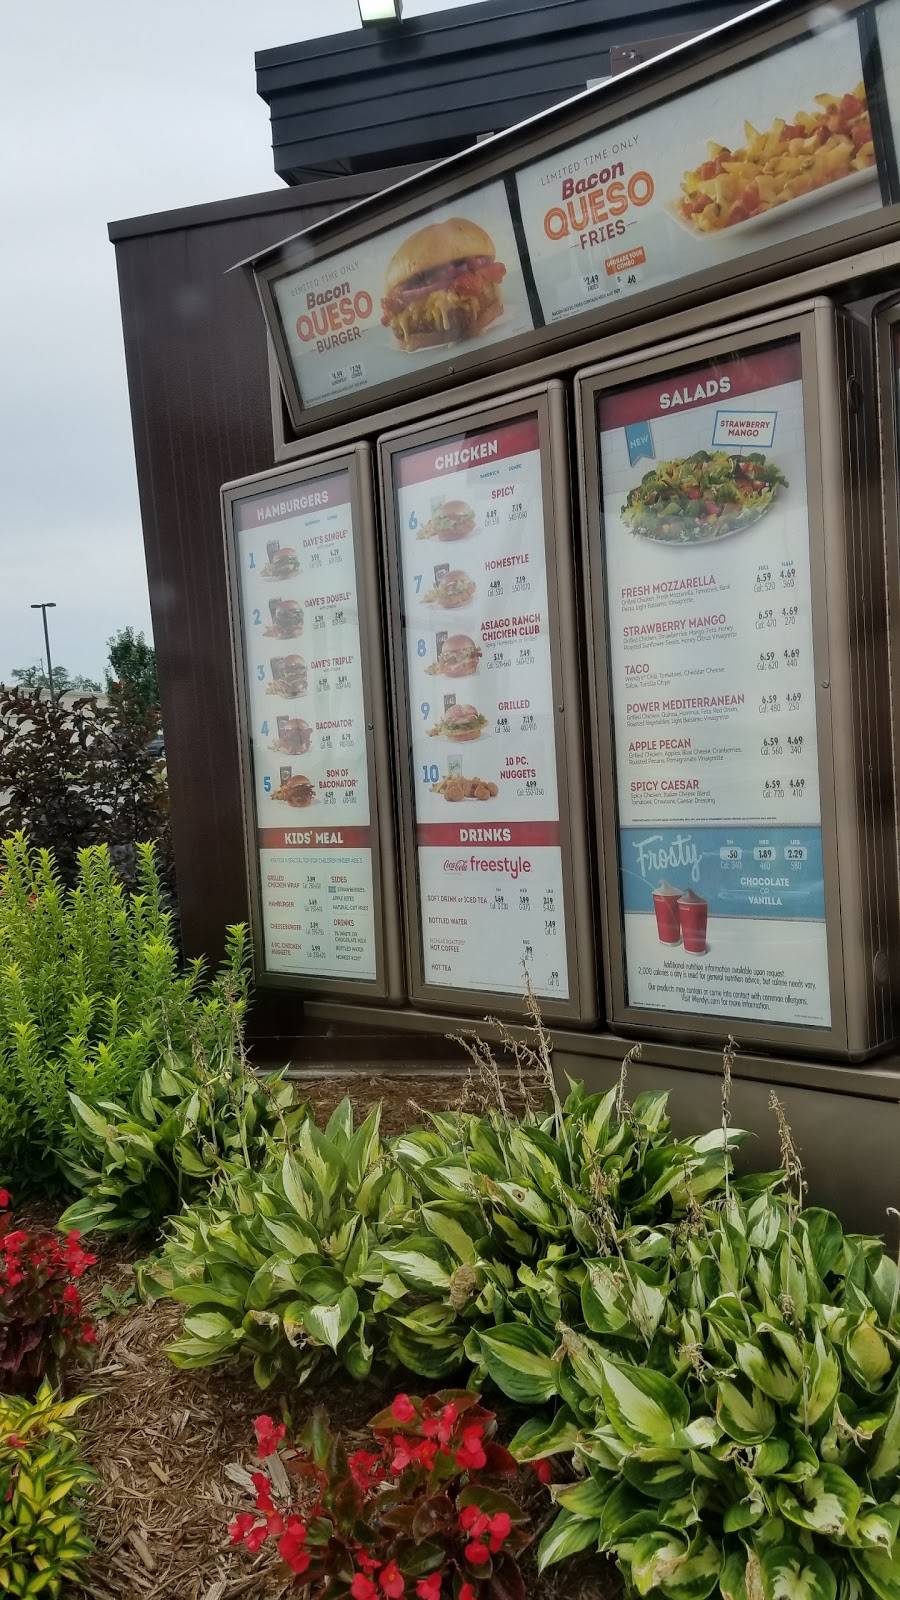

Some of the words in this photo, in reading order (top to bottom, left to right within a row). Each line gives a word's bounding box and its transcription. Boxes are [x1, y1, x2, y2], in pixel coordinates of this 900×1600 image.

[540, 162, 580, 186] LIMITED
[584, 149, 608, 168] TIME
[612, 135, 639, 154] ONLY
[562, 161, 624, 200] Bacon
[544, 170, 654, 240] QUESO
[579, 220, 626, 250] FRIES
[306, 281, 351, 310] Bacon
[296, 290, 373, 342] QUESO
[316, 326, 361, 353] BURGER
[659, 376, 731, 409] SALADS
[720, 420, 770, 429] STRAWBERRY
[728, 429, 759, 437] MANGO
[630, 434, 649, 449] NEW
[434, 439, 498, 470] CHICKEN
[491, 485, 515, 500] SPICY
[256, 491, 329, 521] HAMBURGERS
[408, 511, 418, 530] 6
[249, 552, 256, 569] 1
[485, 554, 529, 571] HOMESTYLE
[414, 574, 423, 594] 7
[621, 584, 650, 598] FRESH
[652, 575, 716, 593] MOZZARELLA
[756, 572, 771, 583] 6.59
[780, 568, 796, 578] 4.69
[252, 608, 262, 625] 2
[481, 617, 510, 631] ASIAGO
[512, 613, 541, 626] RANCH
[623, 619, 686, 638] STRAWBERRY
[688, 614, 726, 629] MANGO
[758, 609, 773, 620] 6.59
[482, 627, 517, 641] CHICKEN
[519, 624, 540, 636] CLUB
[417, 639, 427, 657] 8
[624, 663, 650, 675] TACO
[759, 651, 775, 661] 6.59
[783, 648, 800, 659] 4.69
[257, 665, 265, 681] 3
[420, 702, 431, 720] 9
[498, 699, 530, 711] GRILLED
[626, 701, 661, 714] POWER
[662, 693, 745, 711] MEDITERRANEAN
[761, 694, 777, 704] 6.59
[260, 720, 269, 736] 4
[316, 719, 352, 731] BACONATOR
[628, 740, 657, 751] APPLE
[659, 738, 692, 750] PECAN
[763, 737, 779, 746] 6.59
[787, 735, 803, 745] 4.69
[505, 757, 514, 766] 10
[516, 756, 529, 766] PC.
[326, 768, 339, 778] SON
[422, 764, 439, 783] 10
[500, 769, 537, 780] NUGGETS
[263, 776, 272, 792] 5
[318, 780, 356, 790] BACONATOR
[630, 781, 659, 792] SPICY
[661, 779, 700, 791] CAESAR
[765, 780, 781, 789] 6.59
[789, 778, 805, 788] 4.69
[284, 831, 313, 845] KIDS'
[315, 831, 343, 844] MEAL
[459, 828, 512, 842] DRINKS
[632, 834, 703, 882] Frosty
[728, 849, 738, 859] .50
[758, 849, 772, 859] 1.89
[788, 849, 803, 859] 2.29
[470, 855, 531, 879] freestyle
[740, 876, 790, 888] CHOCOLATE
[440, 895, 457, 903] DRINK
[477, 896, 488, 904] TEA
[748, 895, 783, 906] VANILLA
[333, 919, 355, 927] DRINKS
[428, 916, 449, 925] BOTTLED
[449, 917, 468, 926] WATER
[440, 944, 460, 953] COFFEE
[442, 964, 452, 972] TEA
